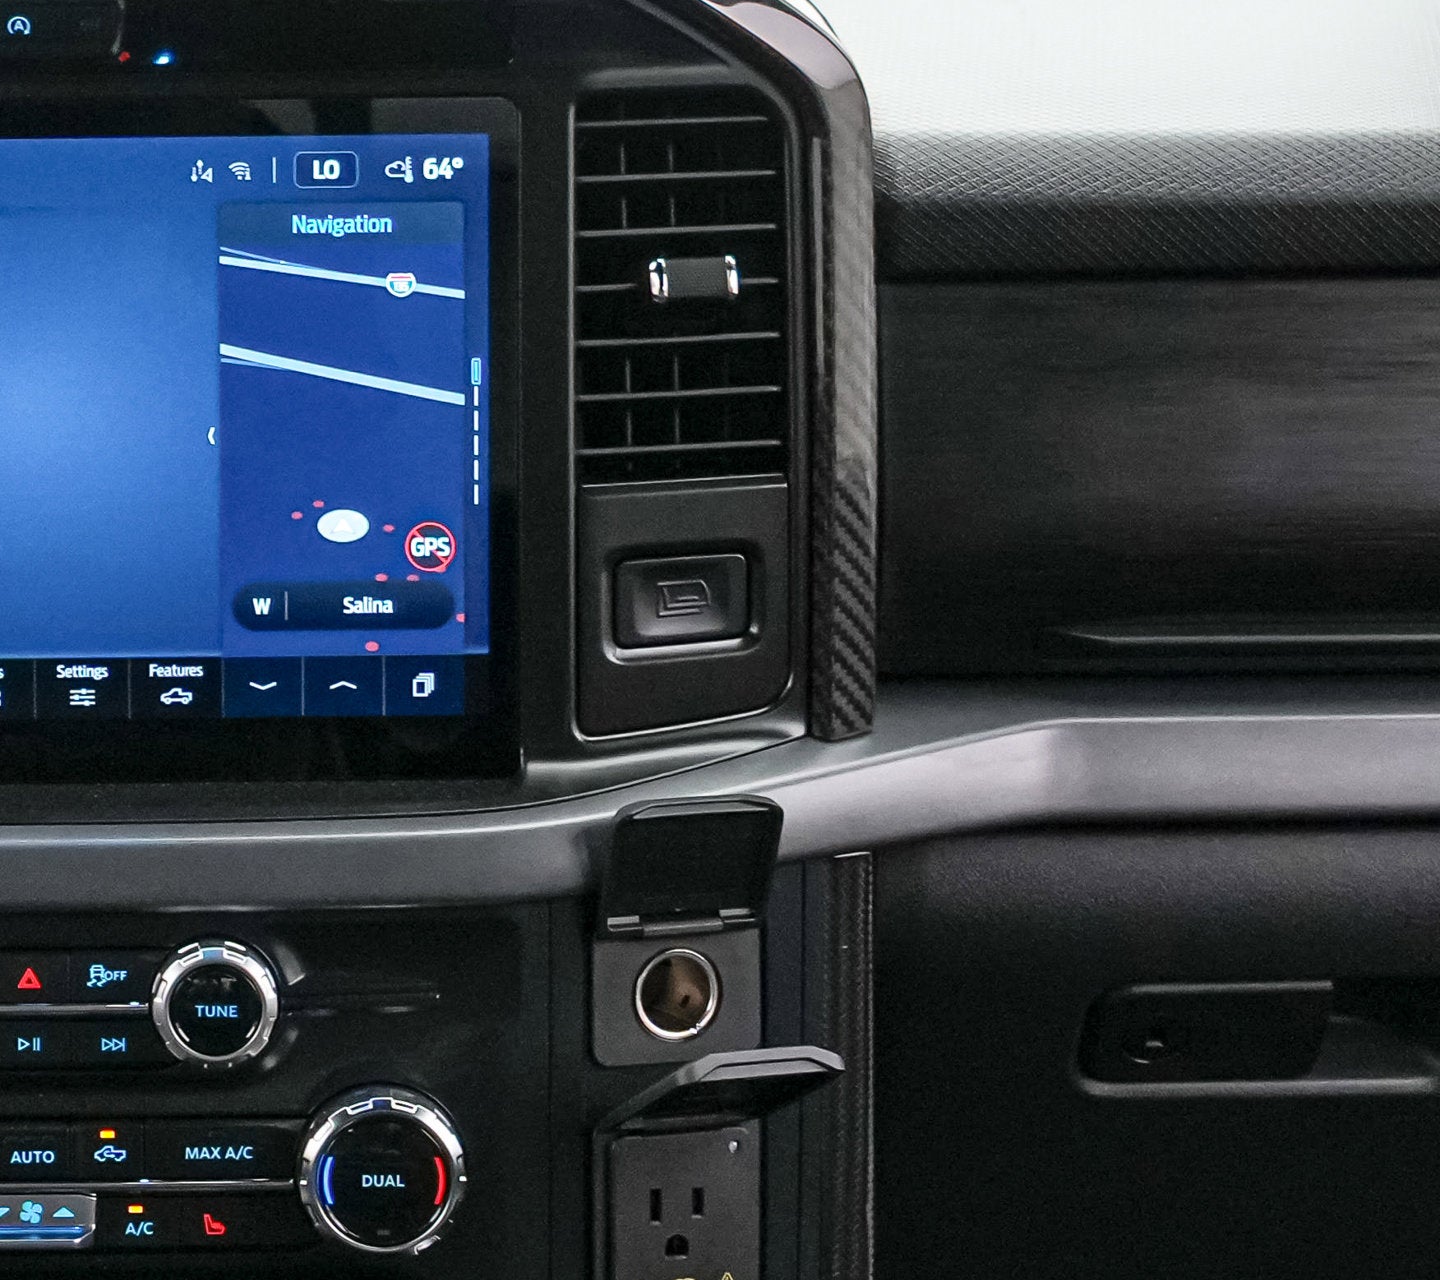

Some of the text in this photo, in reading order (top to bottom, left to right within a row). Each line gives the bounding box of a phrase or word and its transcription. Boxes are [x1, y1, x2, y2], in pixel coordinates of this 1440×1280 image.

[312, 159, 340, 180] LO
[291, 213, 392, 238] Navigation
[410, 535, 450, 558] GPS
[252, 595, 394, 616] W Salina
[56, 663, 108, 682] Settings
[148, 662, 203, 679] Features
[105, 970, 127, 981] OFF
[195, 1005, 238, 1018] TUNE
[10, 1150, 55, 1165] AUTO
[185, 1146, 254, 1160] MAX A/C
[362, 1175, 405, 1188] DUAL
[125, 1222, 154, 1236] A/C
